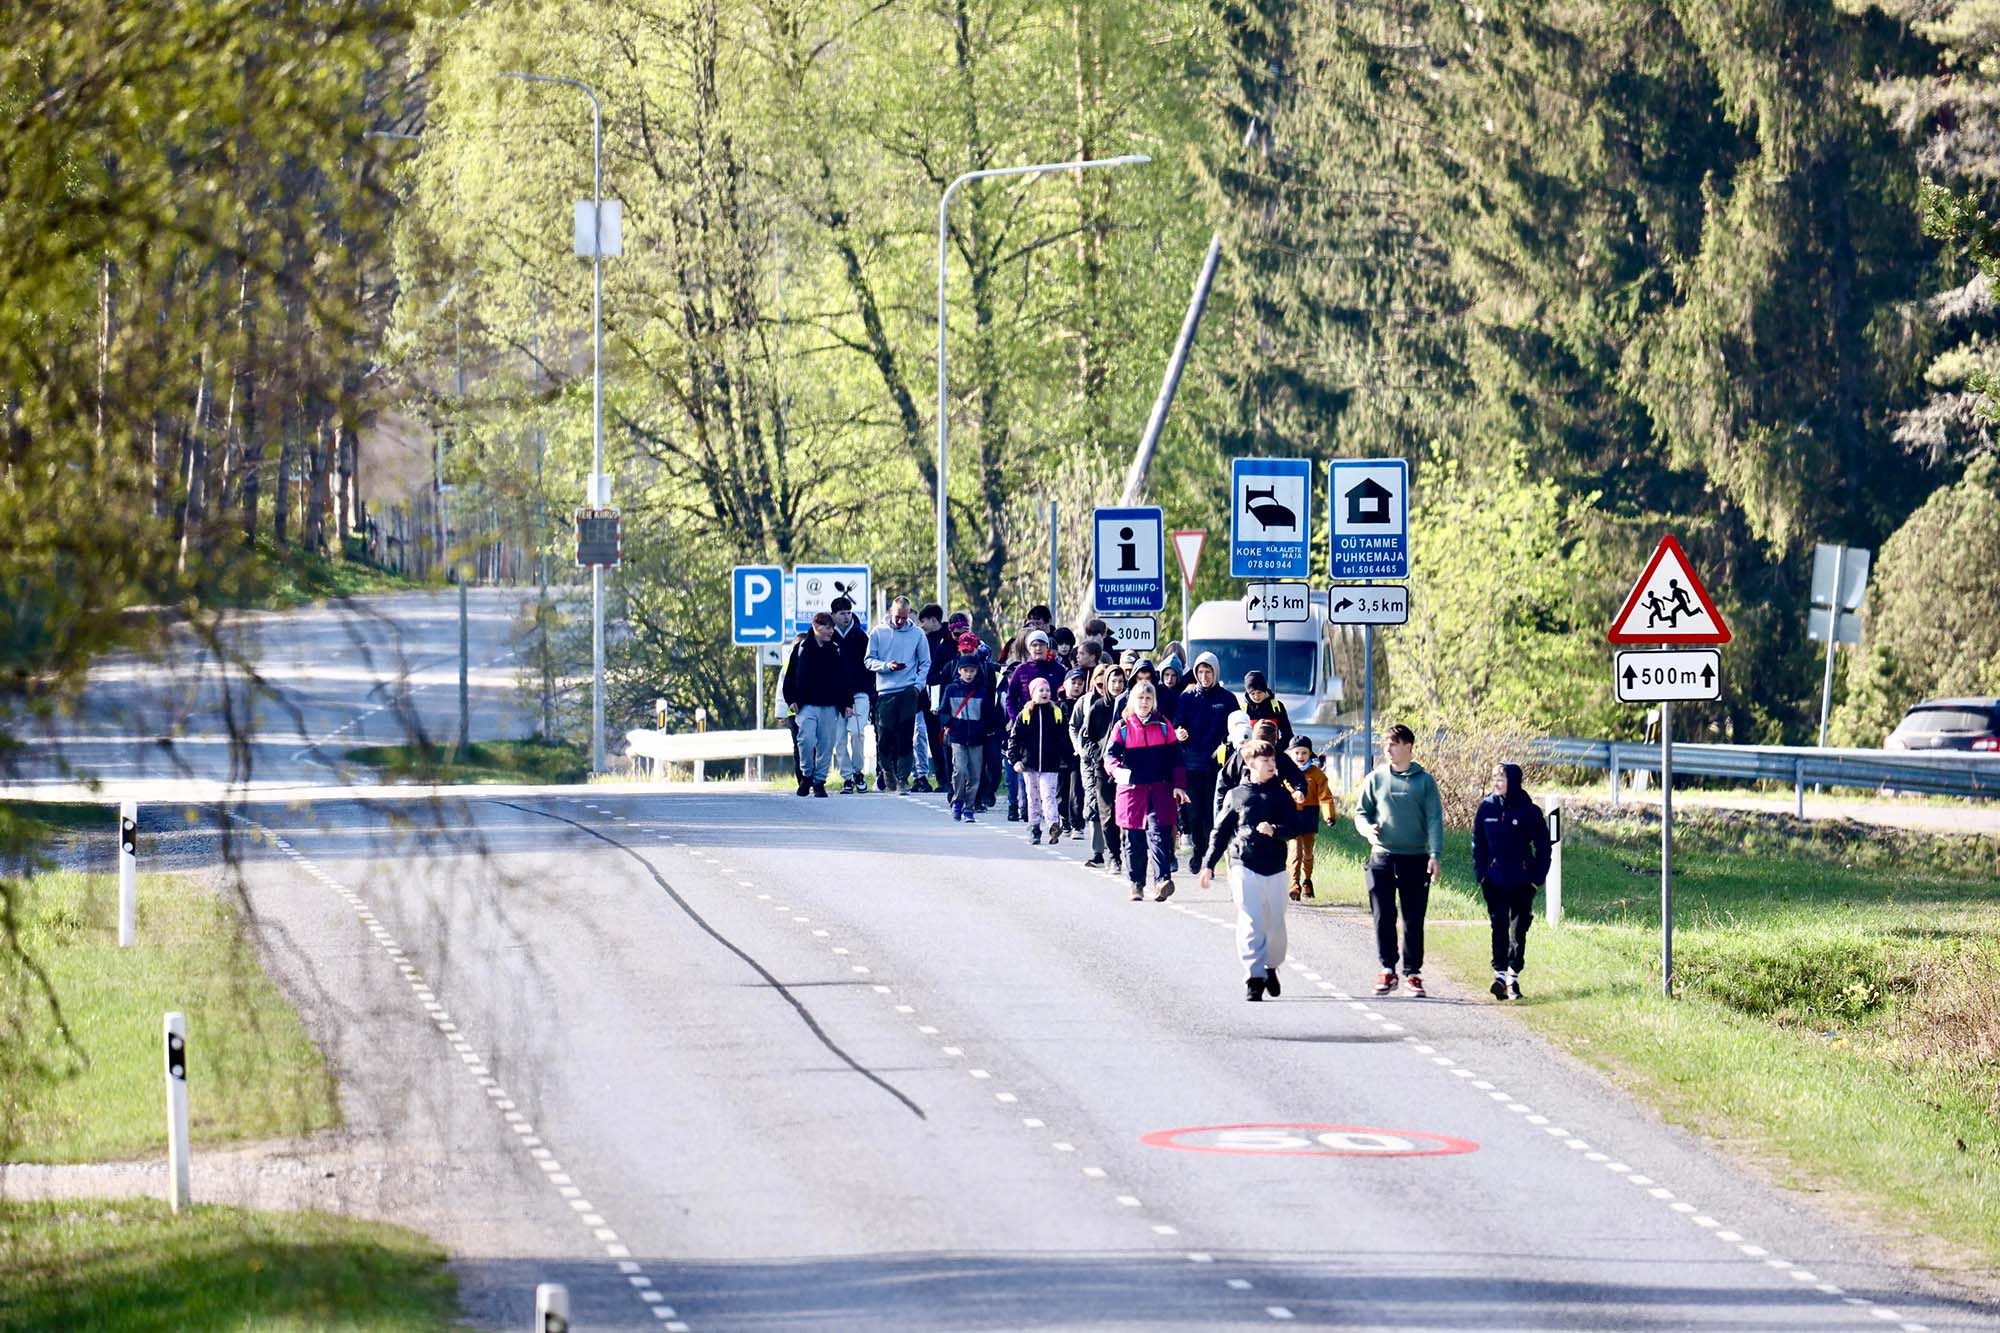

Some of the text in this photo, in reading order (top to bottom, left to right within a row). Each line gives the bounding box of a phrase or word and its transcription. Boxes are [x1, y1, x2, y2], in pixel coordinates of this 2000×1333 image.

[1341, 536, 1399, 549] OÜ TAMME
[1236, 547, 1262, 556] KOKE
[1335, 551, 1404, 563] PUHKEMAJA
[744, 574, 772, 617] P
[1106, 596, 1152, 606] TERMINAL
[1283, 595, 1304, 609] km
[1216, 1129, 1416, 1153] 50
